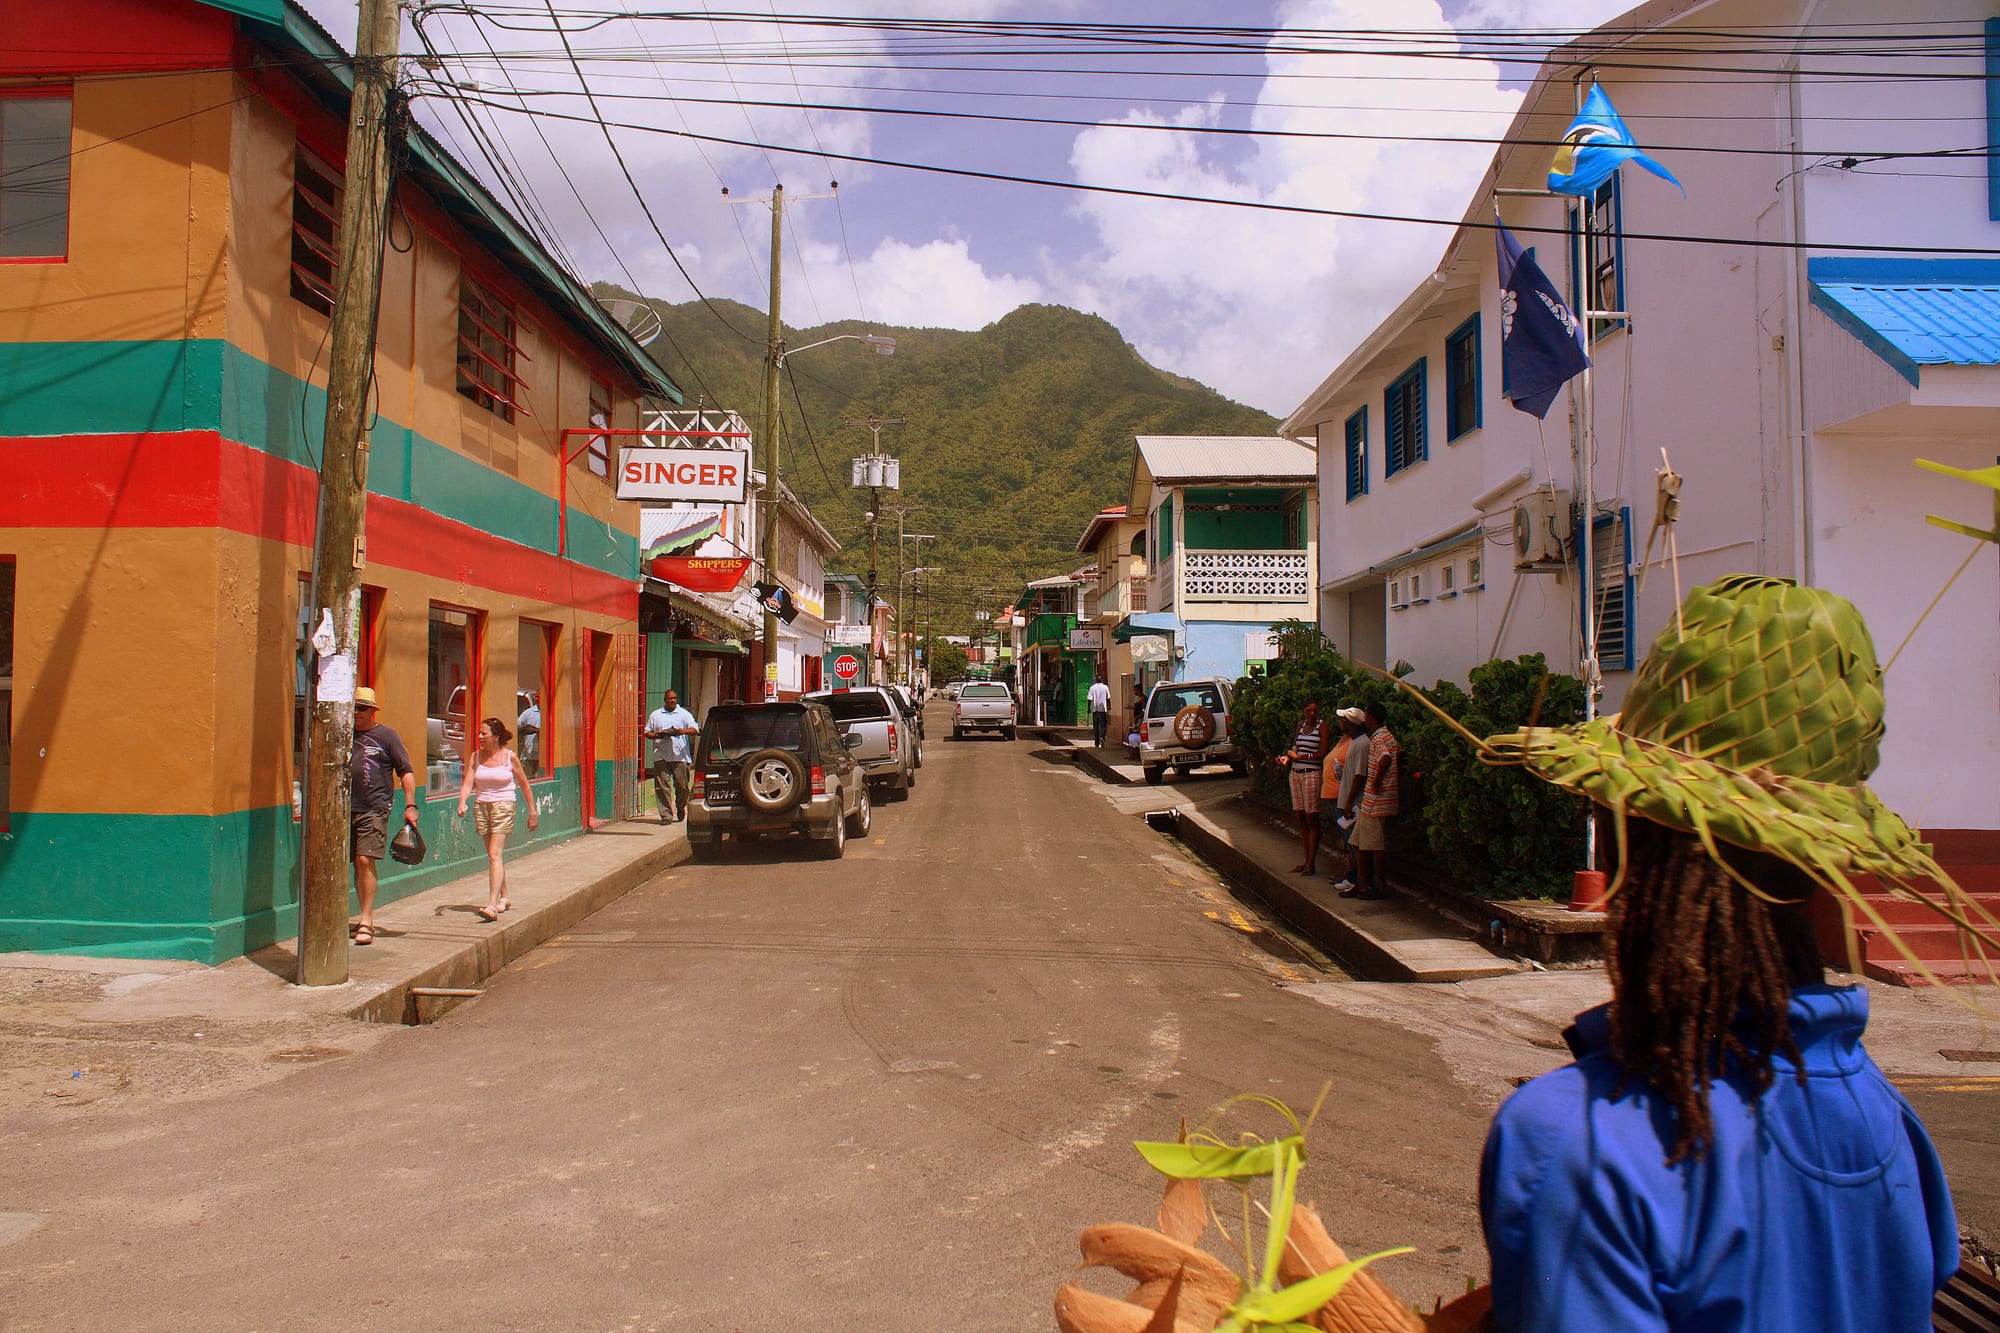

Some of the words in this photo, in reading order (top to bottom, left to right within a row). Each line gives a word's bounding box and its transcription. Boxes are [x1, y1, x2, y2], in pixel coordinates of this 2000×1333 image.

[625, 462, 738, 487] SINGER
[687, 559, 742, 569] SKIPPERS
[836, 661, 857, 672] STOP
